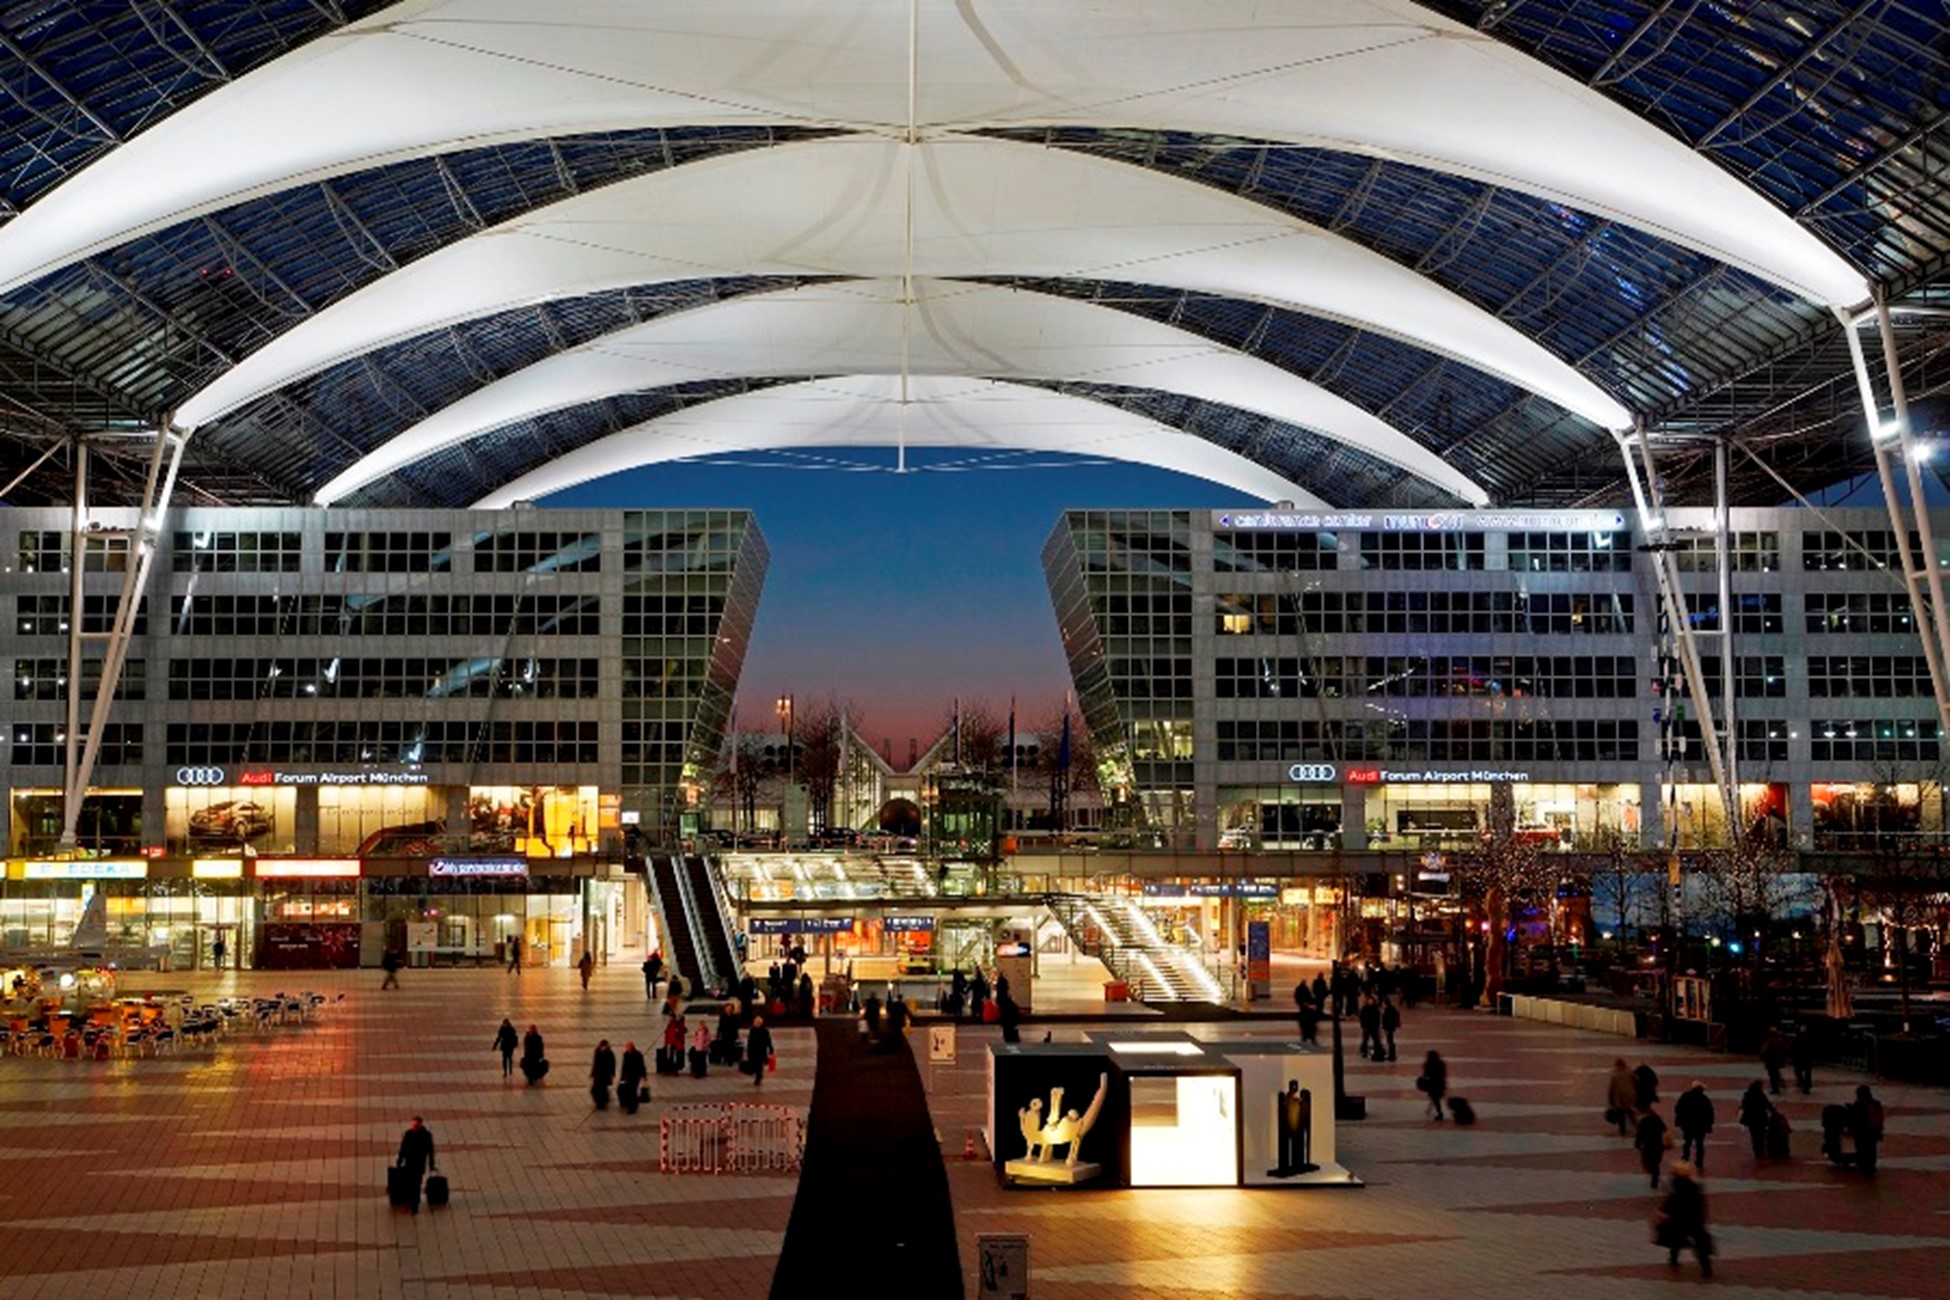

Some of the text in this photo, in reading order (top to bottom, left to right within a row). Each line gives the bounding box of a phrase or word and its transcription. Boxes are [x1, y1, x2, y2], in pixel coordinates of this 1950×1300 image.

[241, 772, 429, 785] Audi Forum Airport München
[1348, 769, 1529, 783] Audi Forum Airport München
[68, 864, 130, 874] EDEKA
